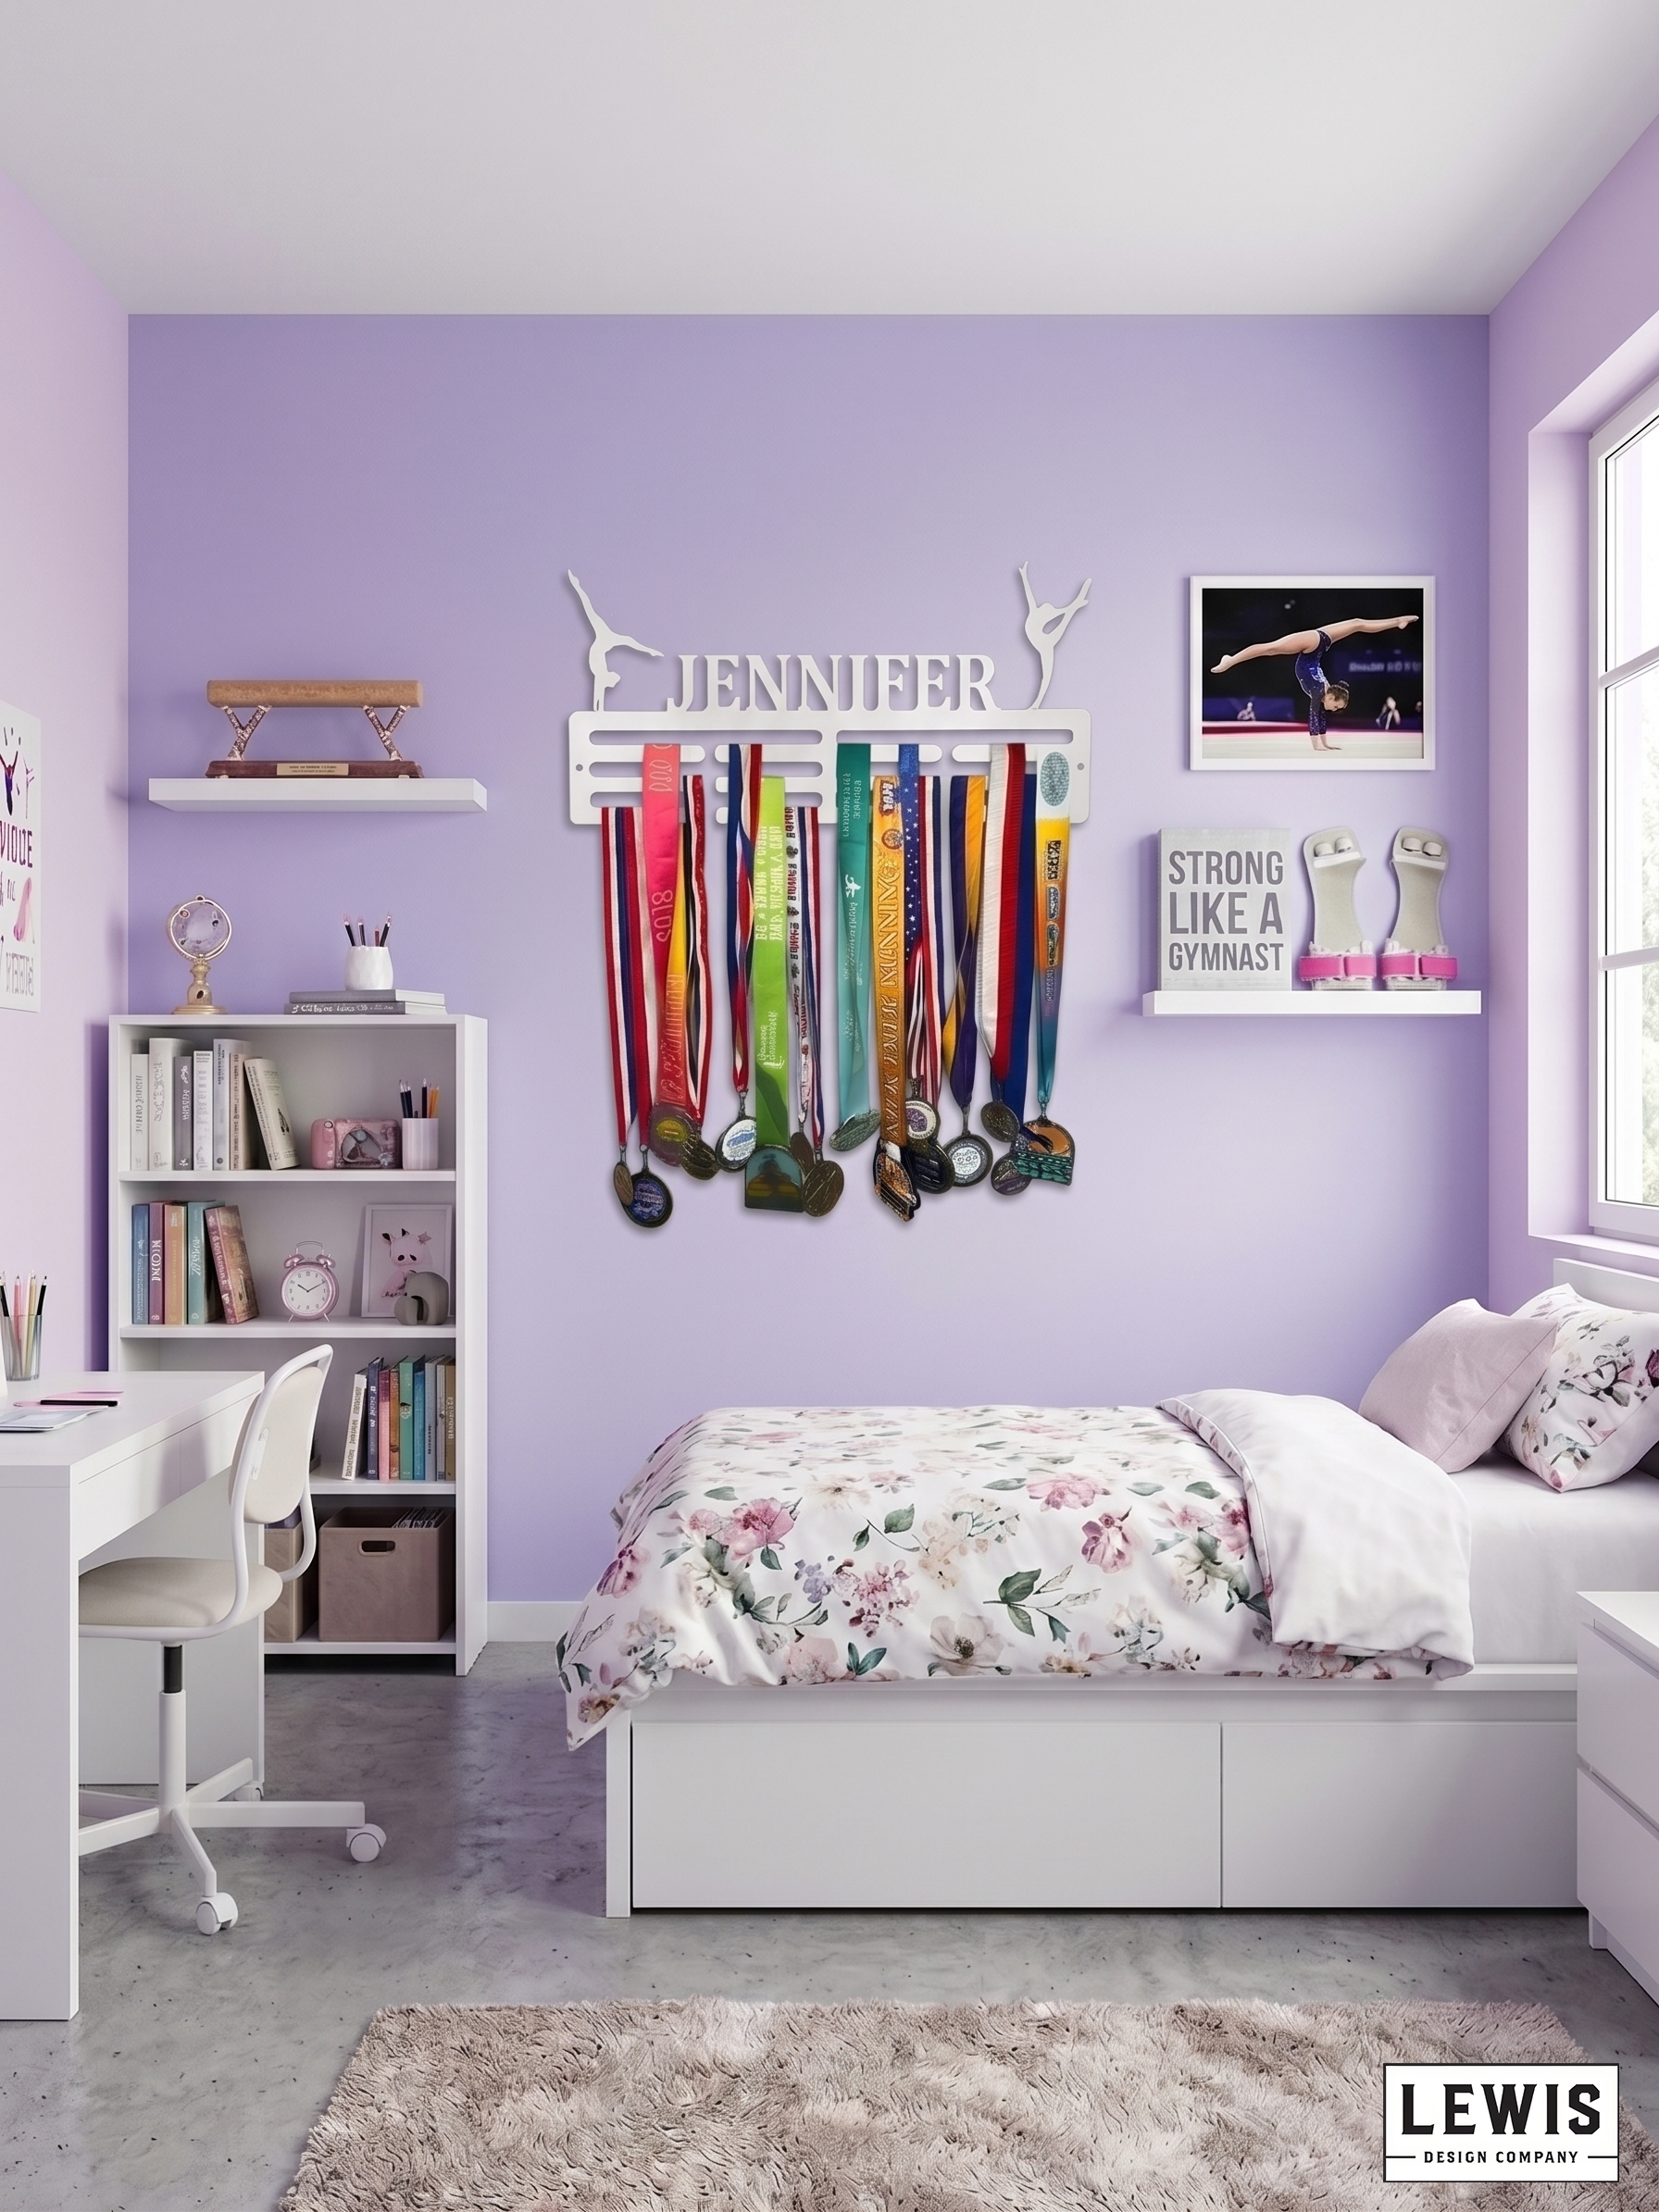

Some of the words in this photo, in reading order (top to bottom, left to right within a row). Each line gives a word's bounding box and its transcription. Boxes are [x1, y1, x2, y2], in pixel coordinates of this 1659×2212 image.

[667, 653, 1002, 712] JENNIFER
[1168, 850, 1284, 886] STRONG
[1169, 891, 1248, 935] LIKE
[1259, 892, 1283, 935] A
[1168, 942, 1284, 971] GYMNAST
